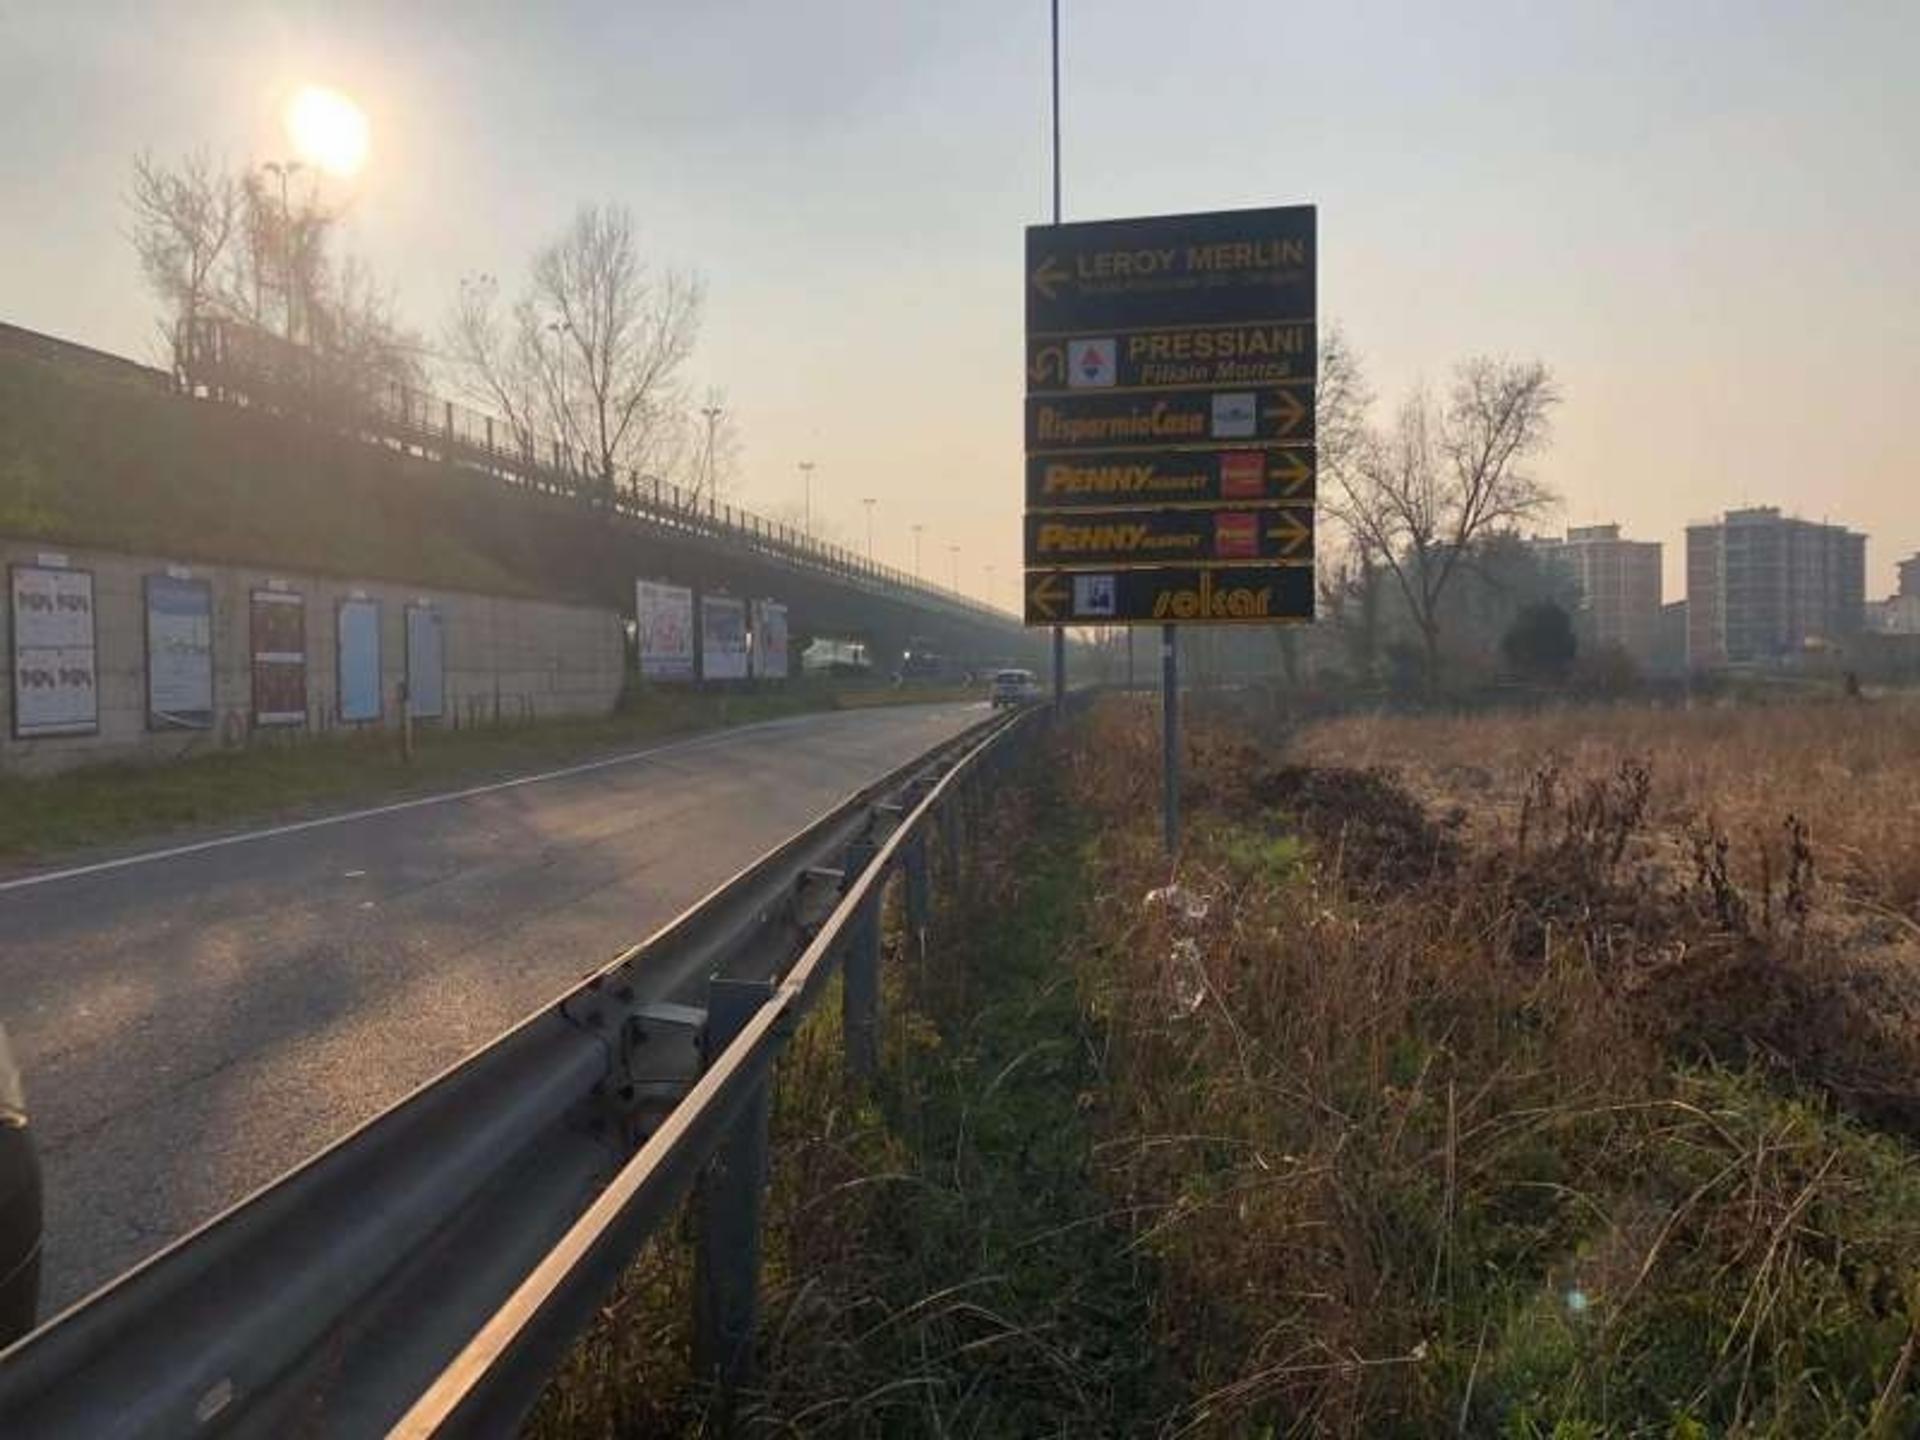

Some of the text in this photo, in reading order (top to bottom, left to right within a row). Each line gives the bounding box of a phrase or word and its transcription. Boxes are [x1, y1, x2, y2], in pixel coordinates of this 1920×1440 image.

[1076, 238, 1305, 279] LEROY MERLIN
[1128, 326, 1305, 362] PRESSIANI
[1043, 464, 1152, 494] PENNY
[1036, 522, 1147, 551] PENNY
